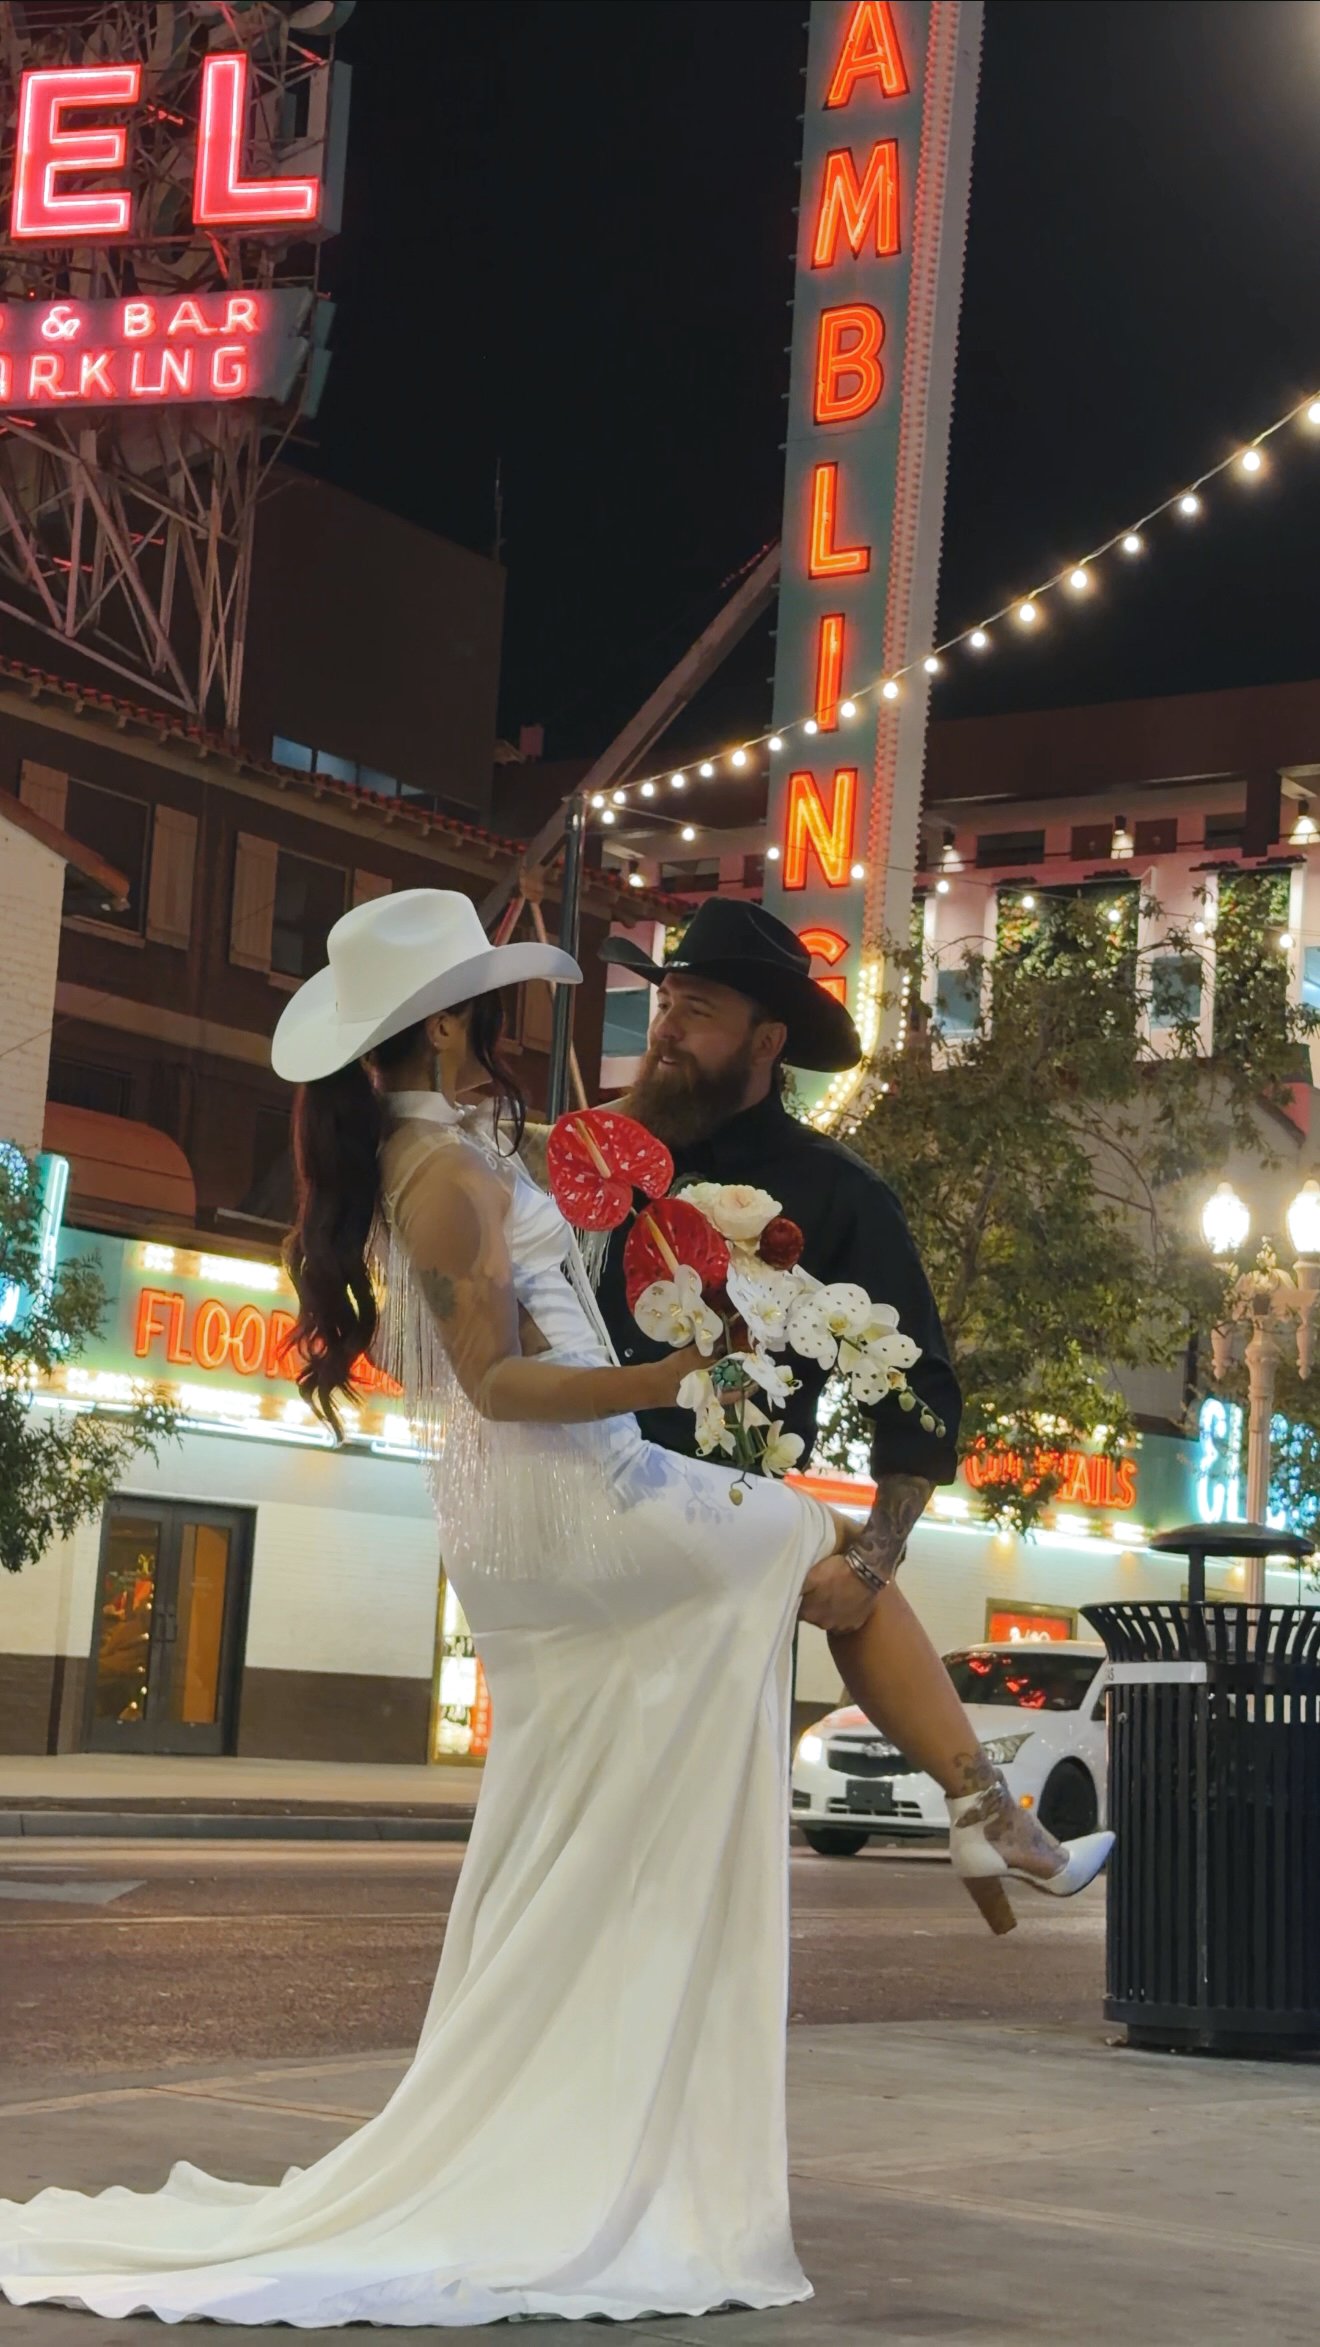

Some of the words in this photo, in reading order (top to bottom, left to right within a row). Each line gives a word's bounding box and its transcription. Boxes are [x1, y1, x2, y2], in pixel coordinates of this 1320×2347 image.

[41, 303, 83, 341] &
[122, 296, 262, 339] BAR
[0, 344, 248, 398] RKING
